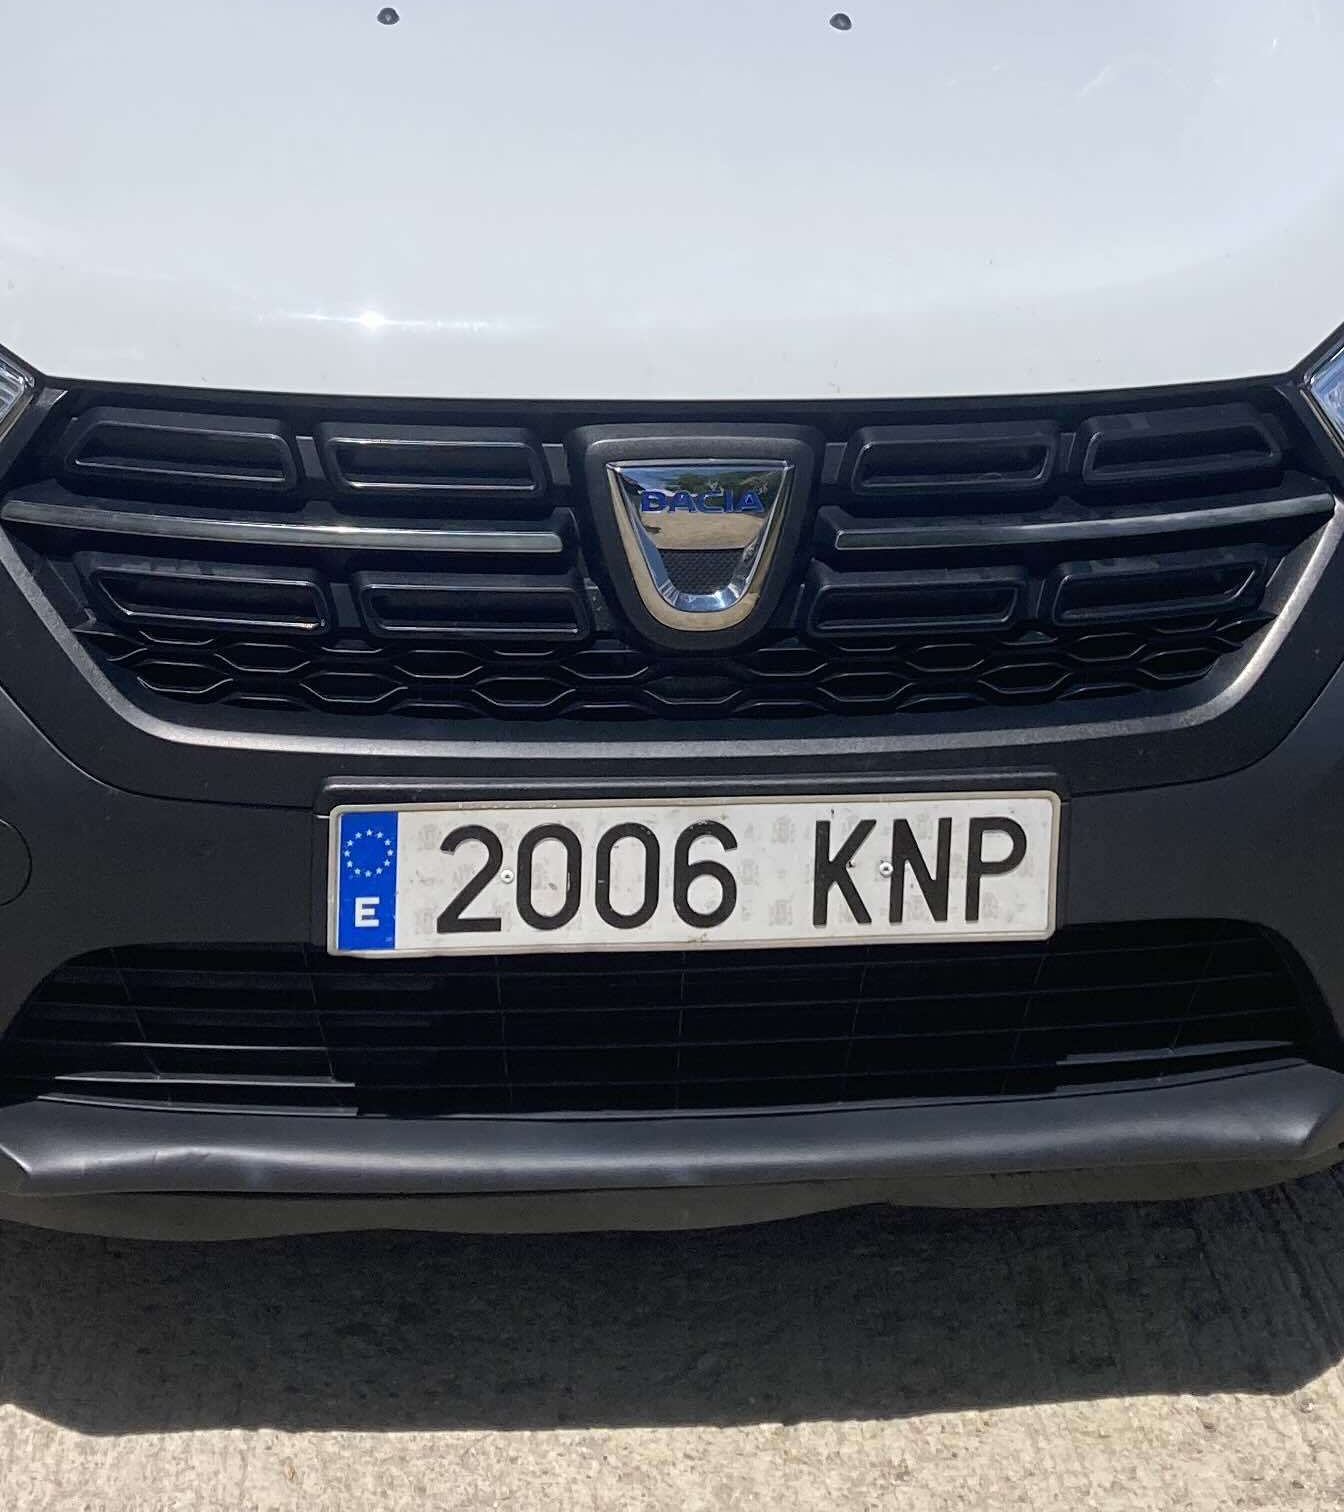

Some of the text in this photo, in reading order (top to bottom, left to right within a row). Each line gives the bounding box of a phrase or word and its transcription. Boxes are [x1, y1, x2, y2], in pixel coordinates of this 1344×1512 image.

[640, 490, 766, 513] DACIA
[436, 816, 1028, 934] 2006 KNP
[355, 897, 380, 928] E
